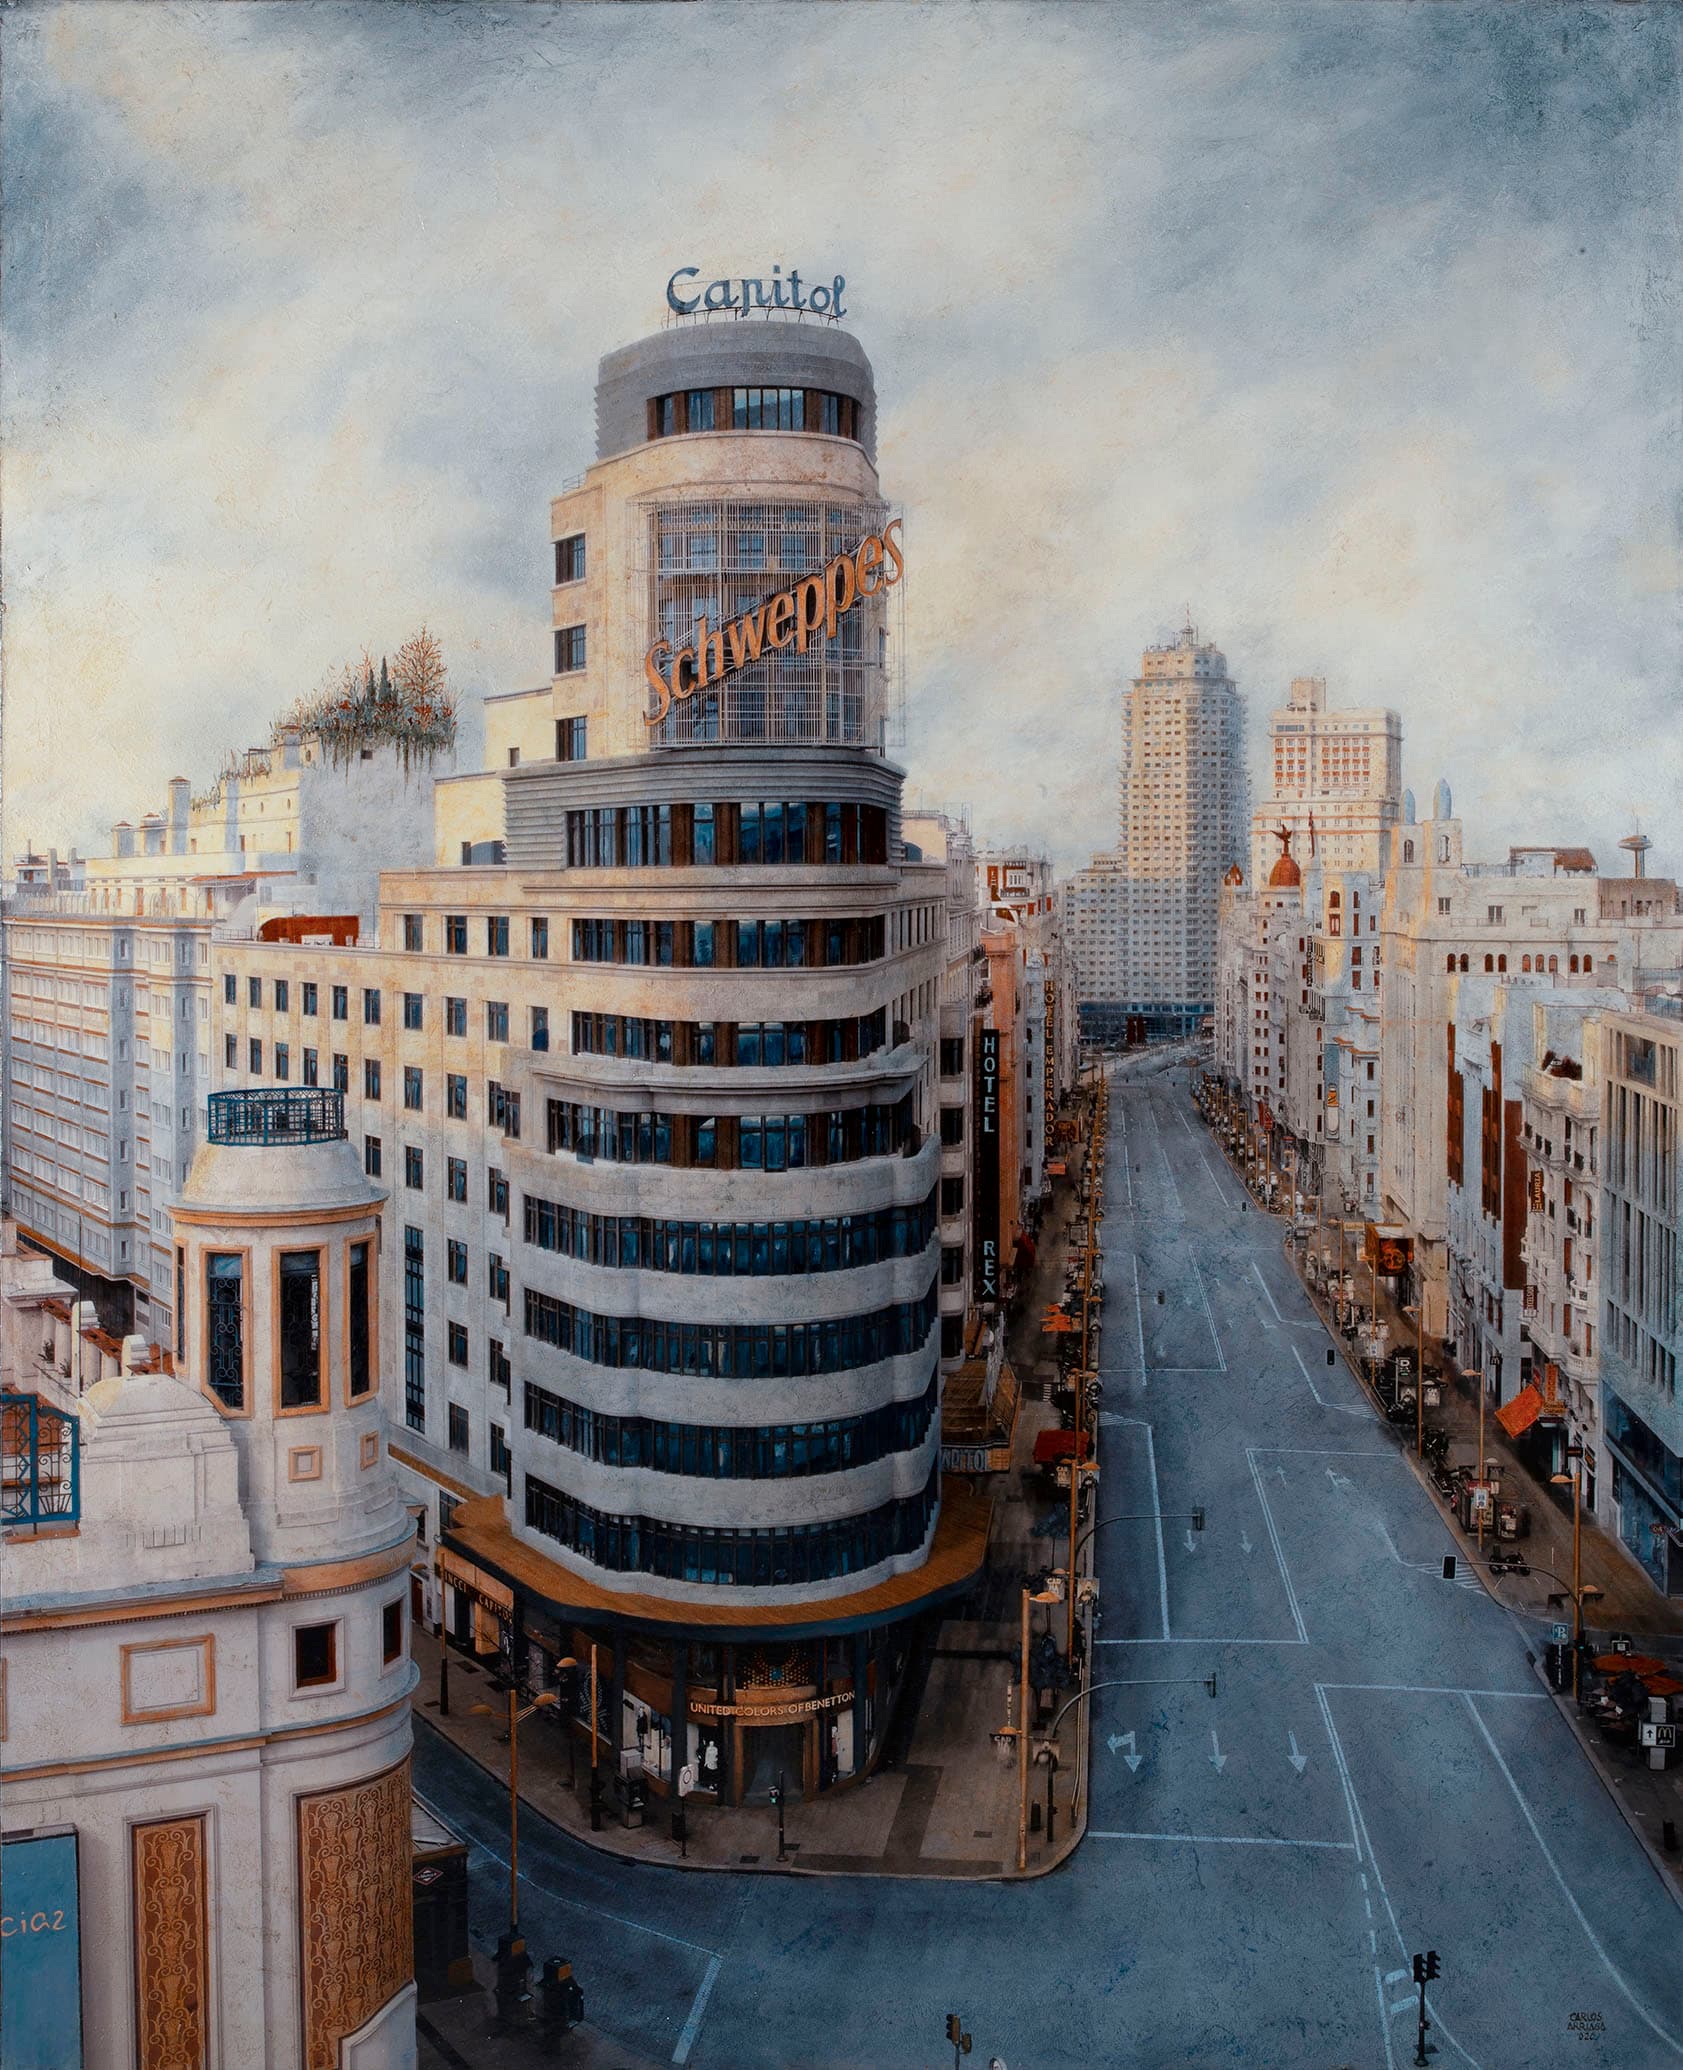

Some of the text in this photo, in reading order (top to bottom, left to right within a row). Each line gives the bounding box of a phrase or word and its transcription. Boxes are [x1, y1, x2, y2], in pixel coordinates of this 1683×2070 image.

[667, 265, 847, 318] Capitol
[643, 518, 904, 727] Schweppes
[1045, 981, 1055, 1146] HOTEL EMPERADOR
[983, 1036, 996, 1295] HOTEL REX
[690, 1691, 856, 1717] UNITED COLORS OF BENETTON
[1569, 2012, 1603, 2021] CARLOS
